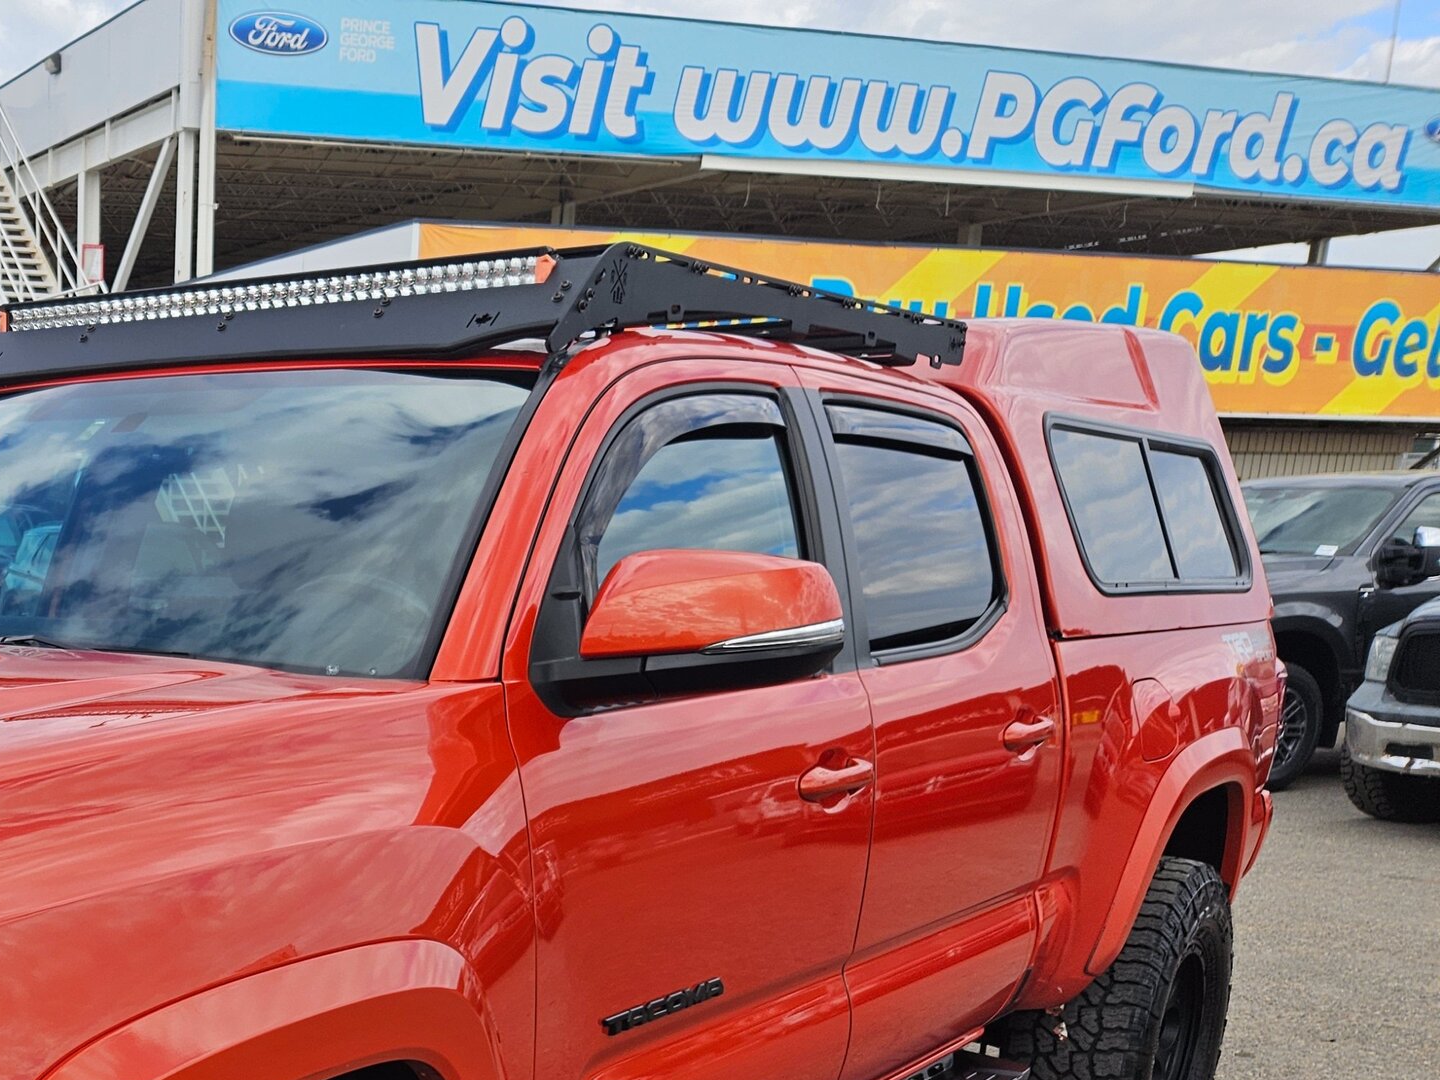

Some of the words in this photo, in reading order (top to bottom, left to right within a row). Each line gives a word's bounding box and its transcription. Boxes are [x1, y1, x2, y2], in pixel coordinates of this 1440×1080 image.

[248, 15, 310, 50] Ford
[341, 17, 392, 34] PRINCE
[340, 34, 396, 49] GEORGE
[340, 49, 377, 62] FORD
[414, 15, 652, 139] Visit
[601, 976, 724, 1036] TACOMA
